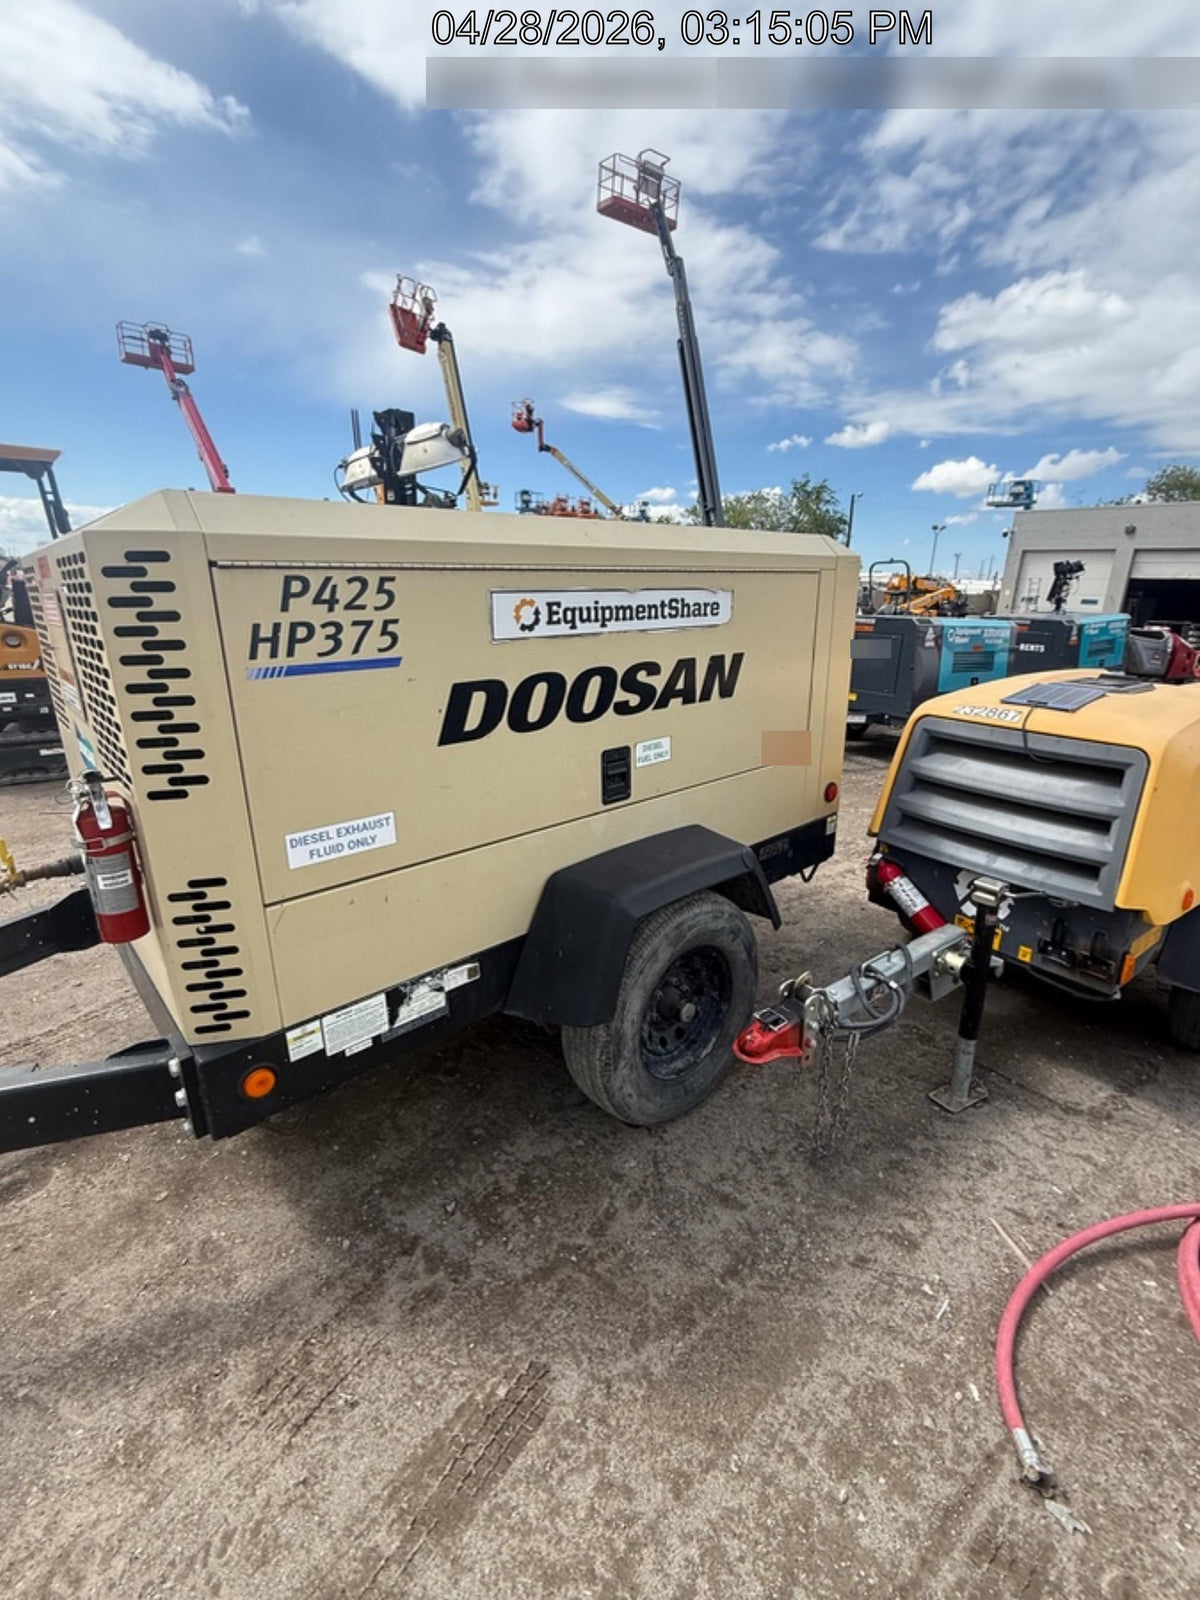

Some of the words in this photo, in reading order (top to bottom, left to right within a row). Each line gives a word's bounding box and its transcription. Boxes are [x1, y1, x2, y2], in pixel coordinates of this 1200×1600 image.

[280, 575, 396, 612] P425
[546, 598, 720, 629] EquipmentShare
[249, 618, 400, 660] HP375
[437, 652, 745, 746] DOOSAN
[289, 830, 335, 849] DIESEL
[335, 816, 392, 838] EXHAUST
[308, 842, 346, 860] FLUID
[347, 834, 378, 851] ONLY
